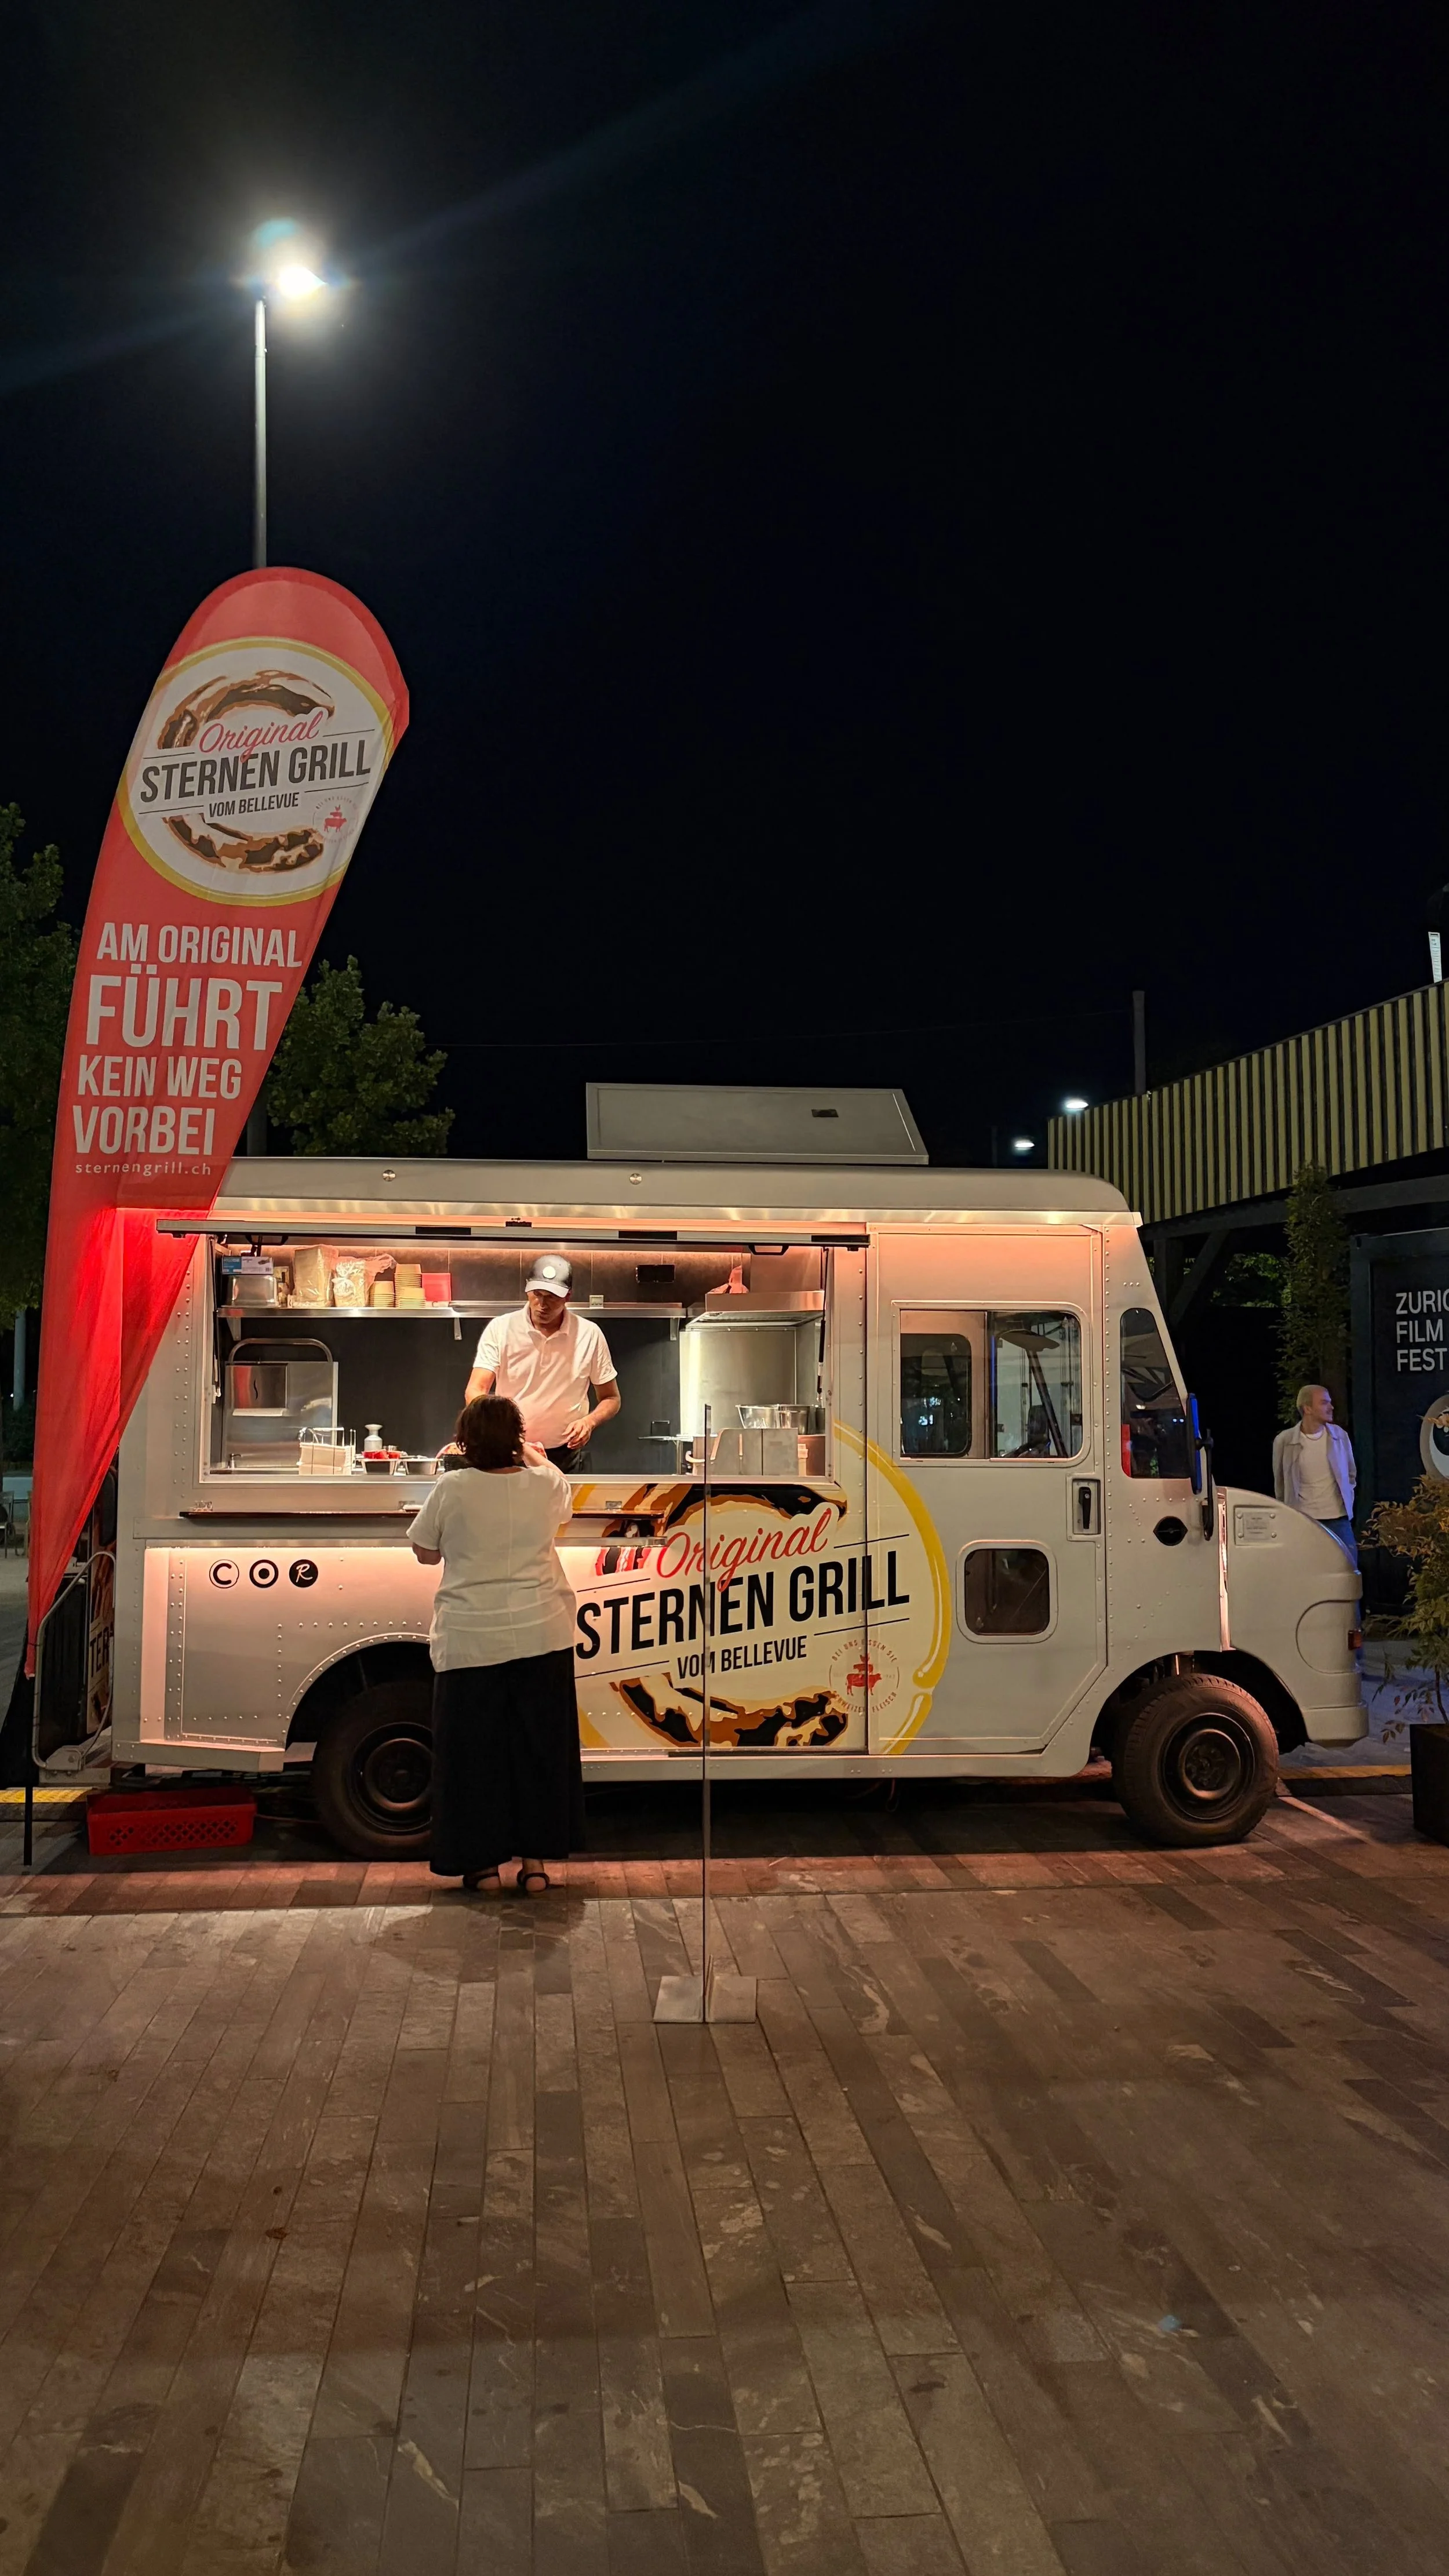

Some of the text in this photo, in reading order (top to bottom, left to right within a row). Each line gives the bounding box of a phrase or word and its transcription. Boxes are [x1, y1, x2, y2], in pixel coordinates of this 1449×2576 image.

[199, 711, 323, 763] Original
[140, 740, 371, 802] STERNEN GRILL
[209, 801, 235, 817] VOM
[239, 792, 299, 814] BELLEVUE
[97, 922, 302, 967] AM ORIGINAL
[86, 963, 282, 1050] FÜHRT
[78, 1055, 242, 1099] KEIN WEG
[73, 1105, 215, 1155] VORBEI
[75, 1162, 211, 1176] sternengrill.ch
[1396, 1319, 1443, 1343] FILM
[657, 1508, 832, 1592] Original
[576, 1551, 910, 1659] STERNEN GRILL
[678, 1635, 807, 1680] VOM BELLEVUE
